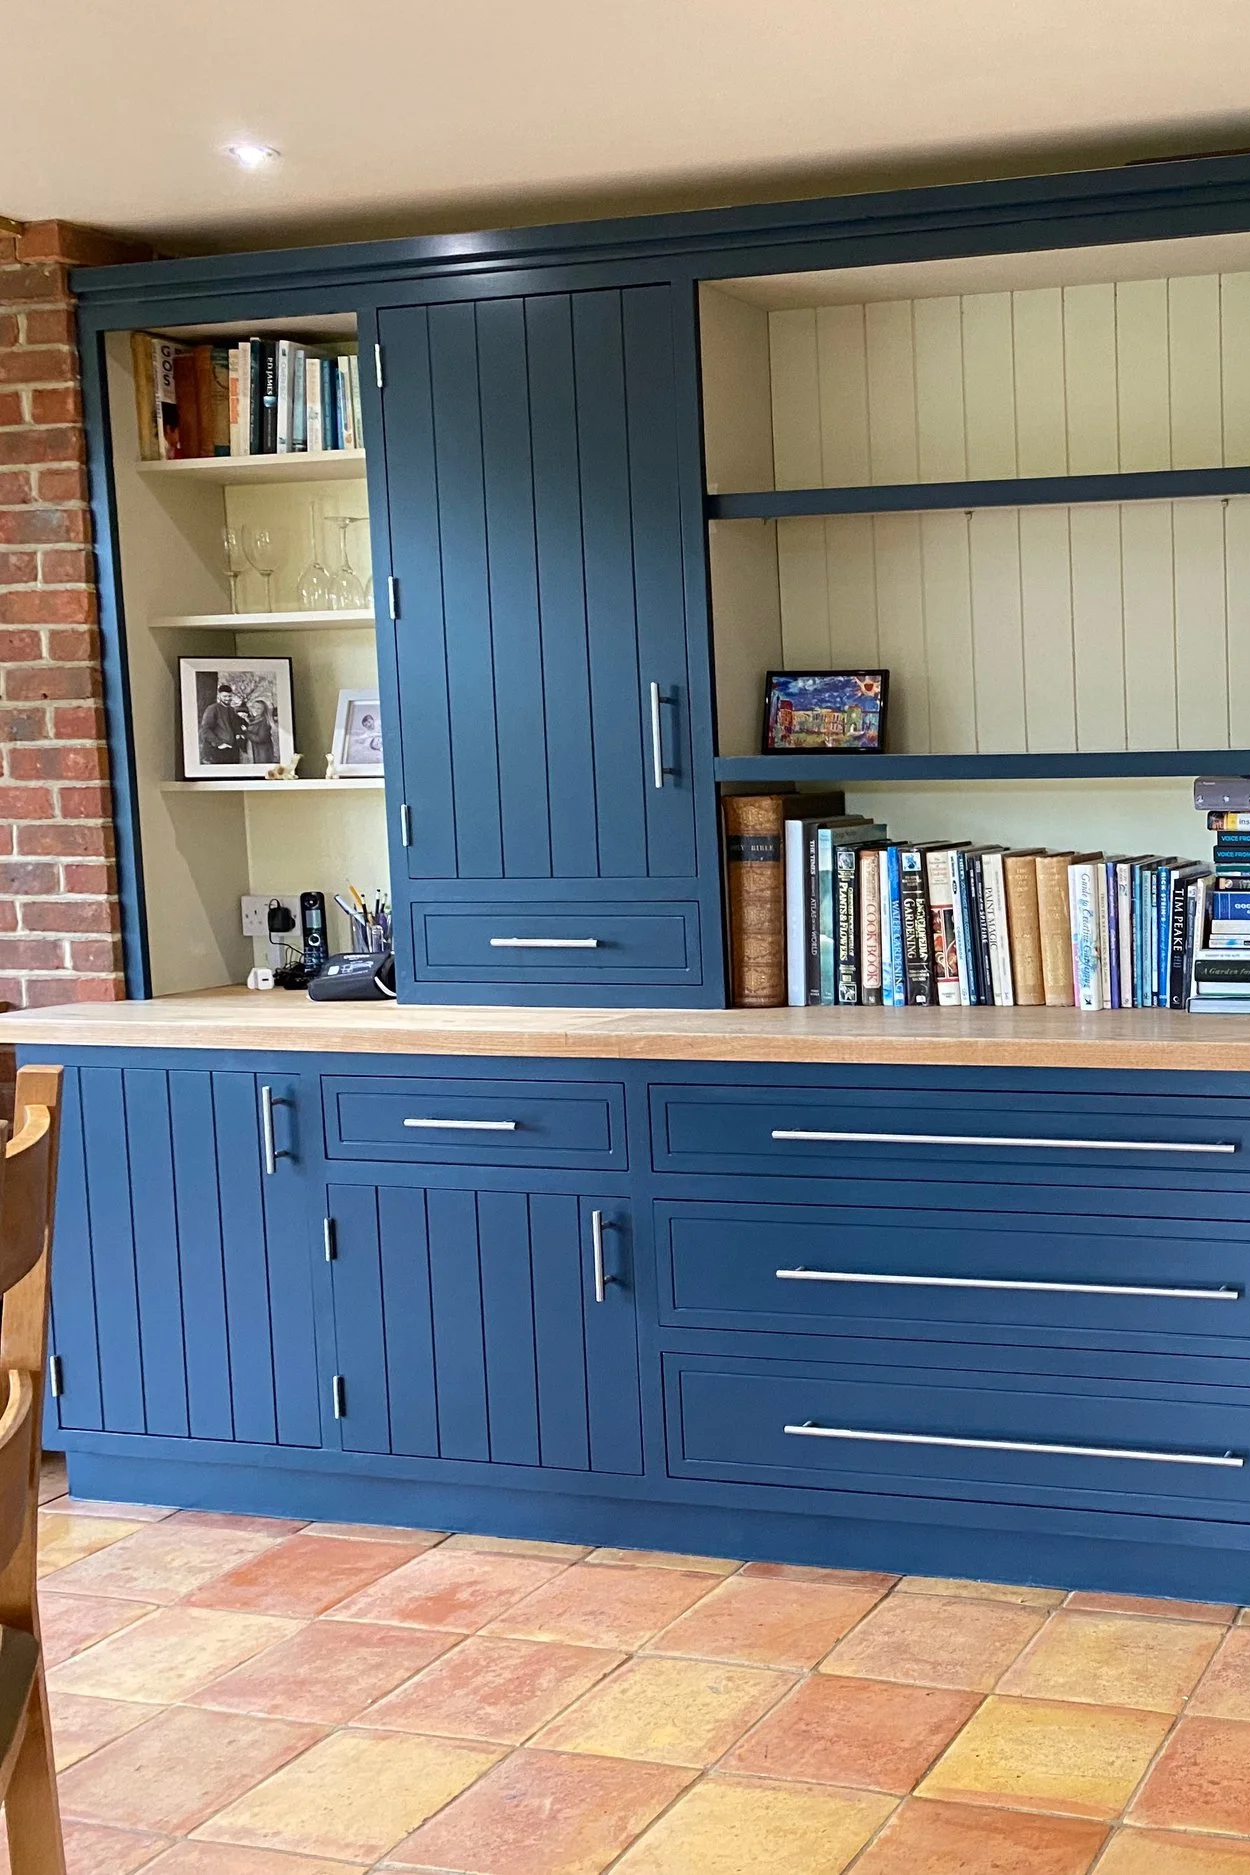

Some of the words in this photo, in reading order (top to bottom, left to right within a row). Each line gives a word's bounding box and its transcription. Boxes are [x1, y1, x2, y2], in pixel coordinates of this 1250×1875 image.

[839, 882, 847, 915] PLANTS
[985, 887, 993, 916] PAINT
[1082, 873, 1090, 898] Guide
[1174, 888, 1184, 912] TIM
[866, 904, 877, 942] COOK
[892, 900, 900, 932] WATER
[904, 898, 916, 958] GARDENING
[915, 898, 928, 959] ENCYCLOPEDIA
[979, 911, 988, 944] SPITFIRE
[1082, 908, 1094, 943] Creative
[1173, 916, 1184, 951] PEAKE
[840, 922, 849, 961] FLOWERS
[987, 918, 998, 951] MAGIC
[867, 945, 878, 983] BOOK
[893, 933, 904, 993] GARDENING
[1079, 945, 1092, 988] Gardening
